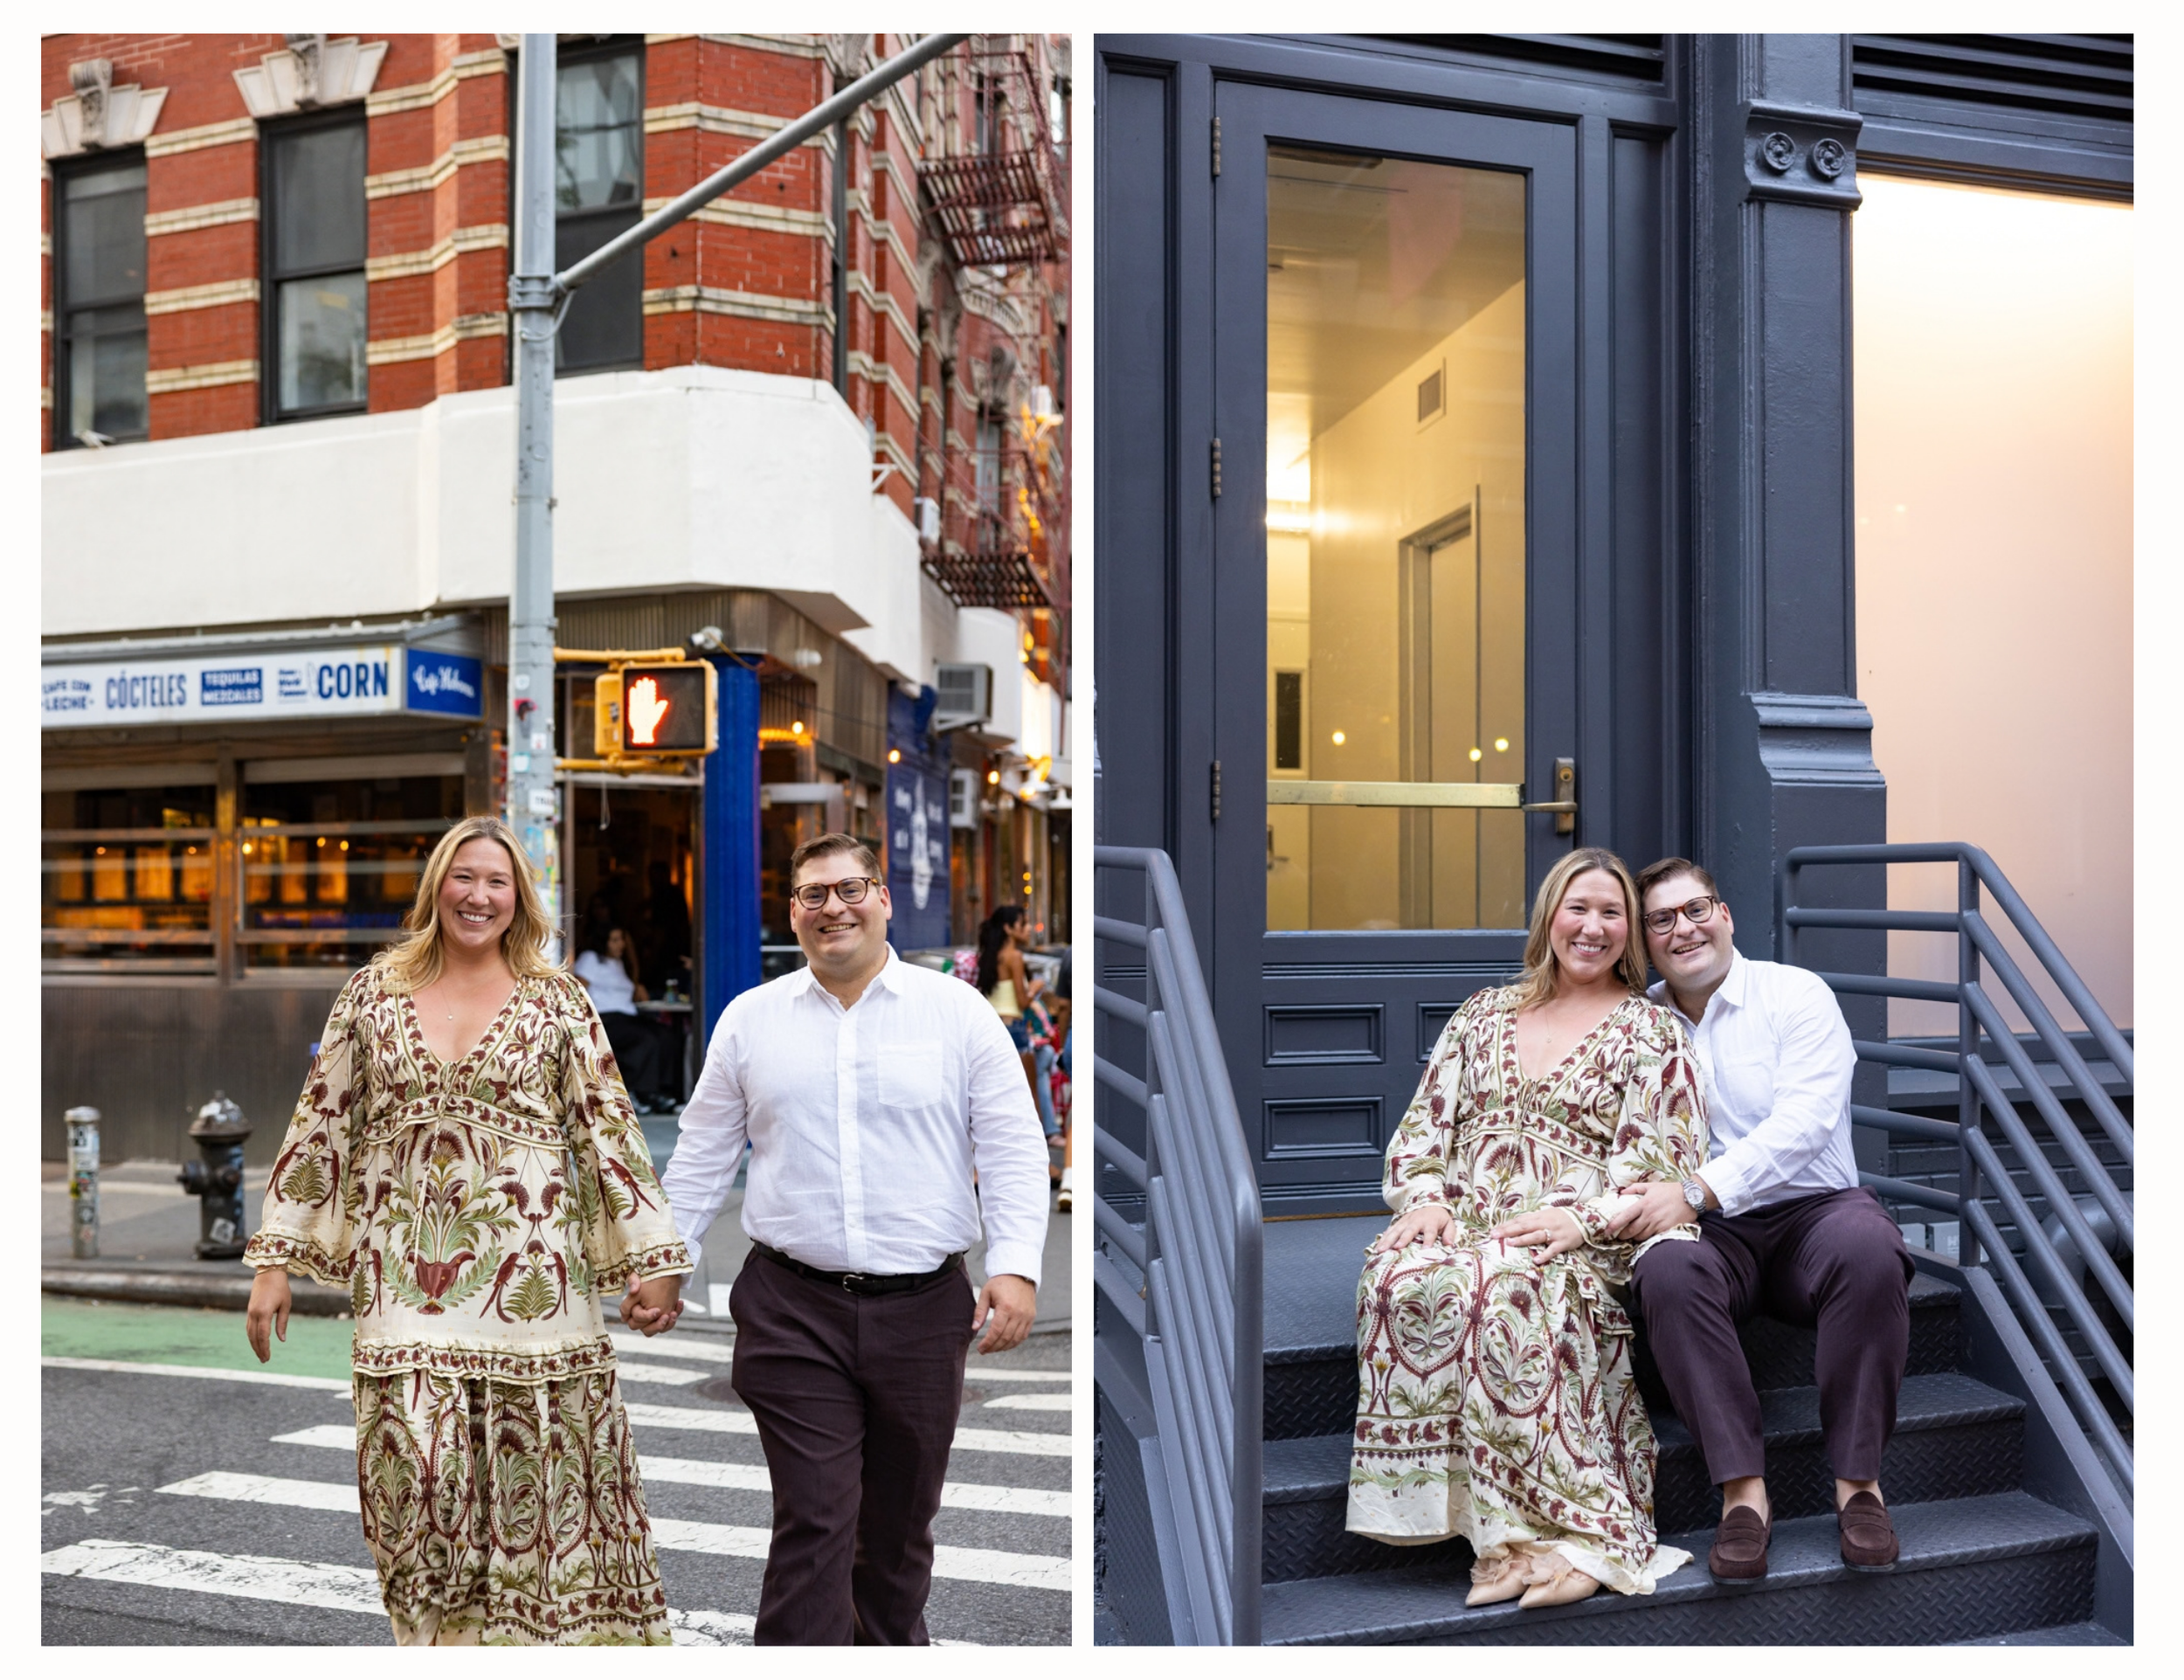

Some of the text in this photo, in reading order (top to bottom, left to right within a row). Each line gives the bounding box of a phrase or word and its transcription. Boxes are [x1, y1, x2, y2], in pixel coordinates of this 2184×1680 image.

[106, 668, 187, 710] CÓCTELES
[204, 669, 259, 688] TEQUILAS
[318, 661, 389, 700] CORN
